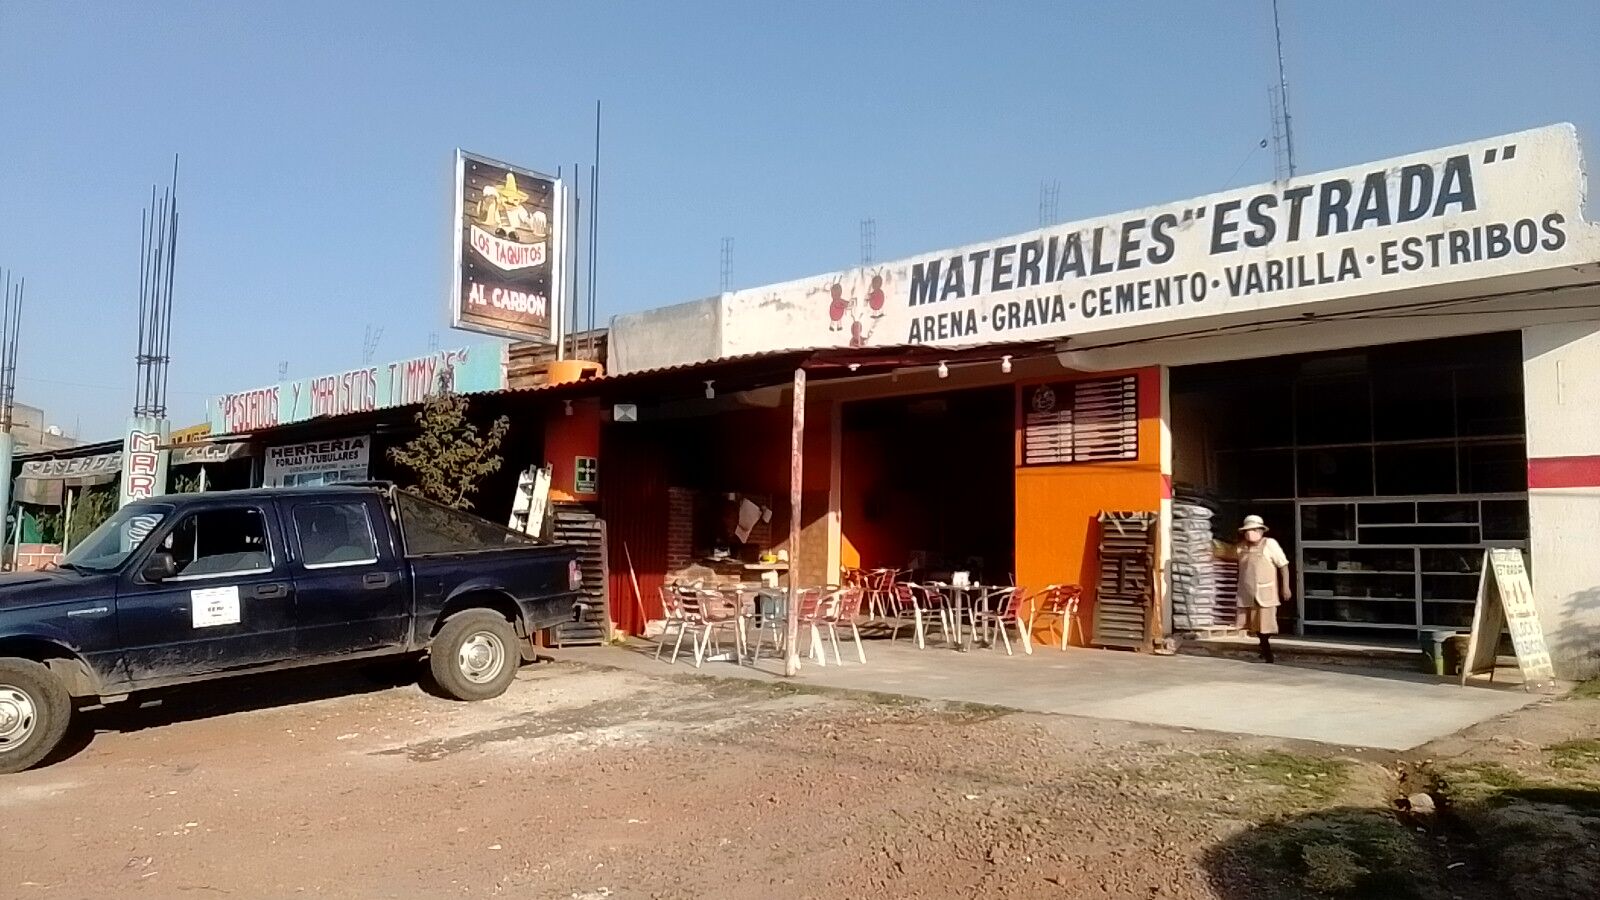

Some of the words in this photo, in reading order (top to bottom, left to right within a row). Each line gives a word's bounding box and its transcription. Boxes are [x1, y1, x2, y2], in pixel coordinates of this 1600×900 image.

[473, 228, 490, 255] LOS
[495, 241, 542, 265] TAQUITOS
[909, 213, 1178, 307] MATERIALES
[908, 308, 979, 344] ARENA
[992, 295, 1067, 331] GRAVA
[1081, 271, 1207, 318] CEMENTO
[1225, 247, 1362, 297] VARILLA
[1380, 213, 1567, 276] ESTRIBOS
[468, 282, 487, 306] AL
[492, 287, 546, 319] CARBON
[292, 381, 302, 423] Y
[310, 367, 377, 418] MARISCOS
[26, 454, 123, 475] PESCADE
[271, 439, 364, 459] HERRERIA
[311, 449, 359, 465] TUBULARES
